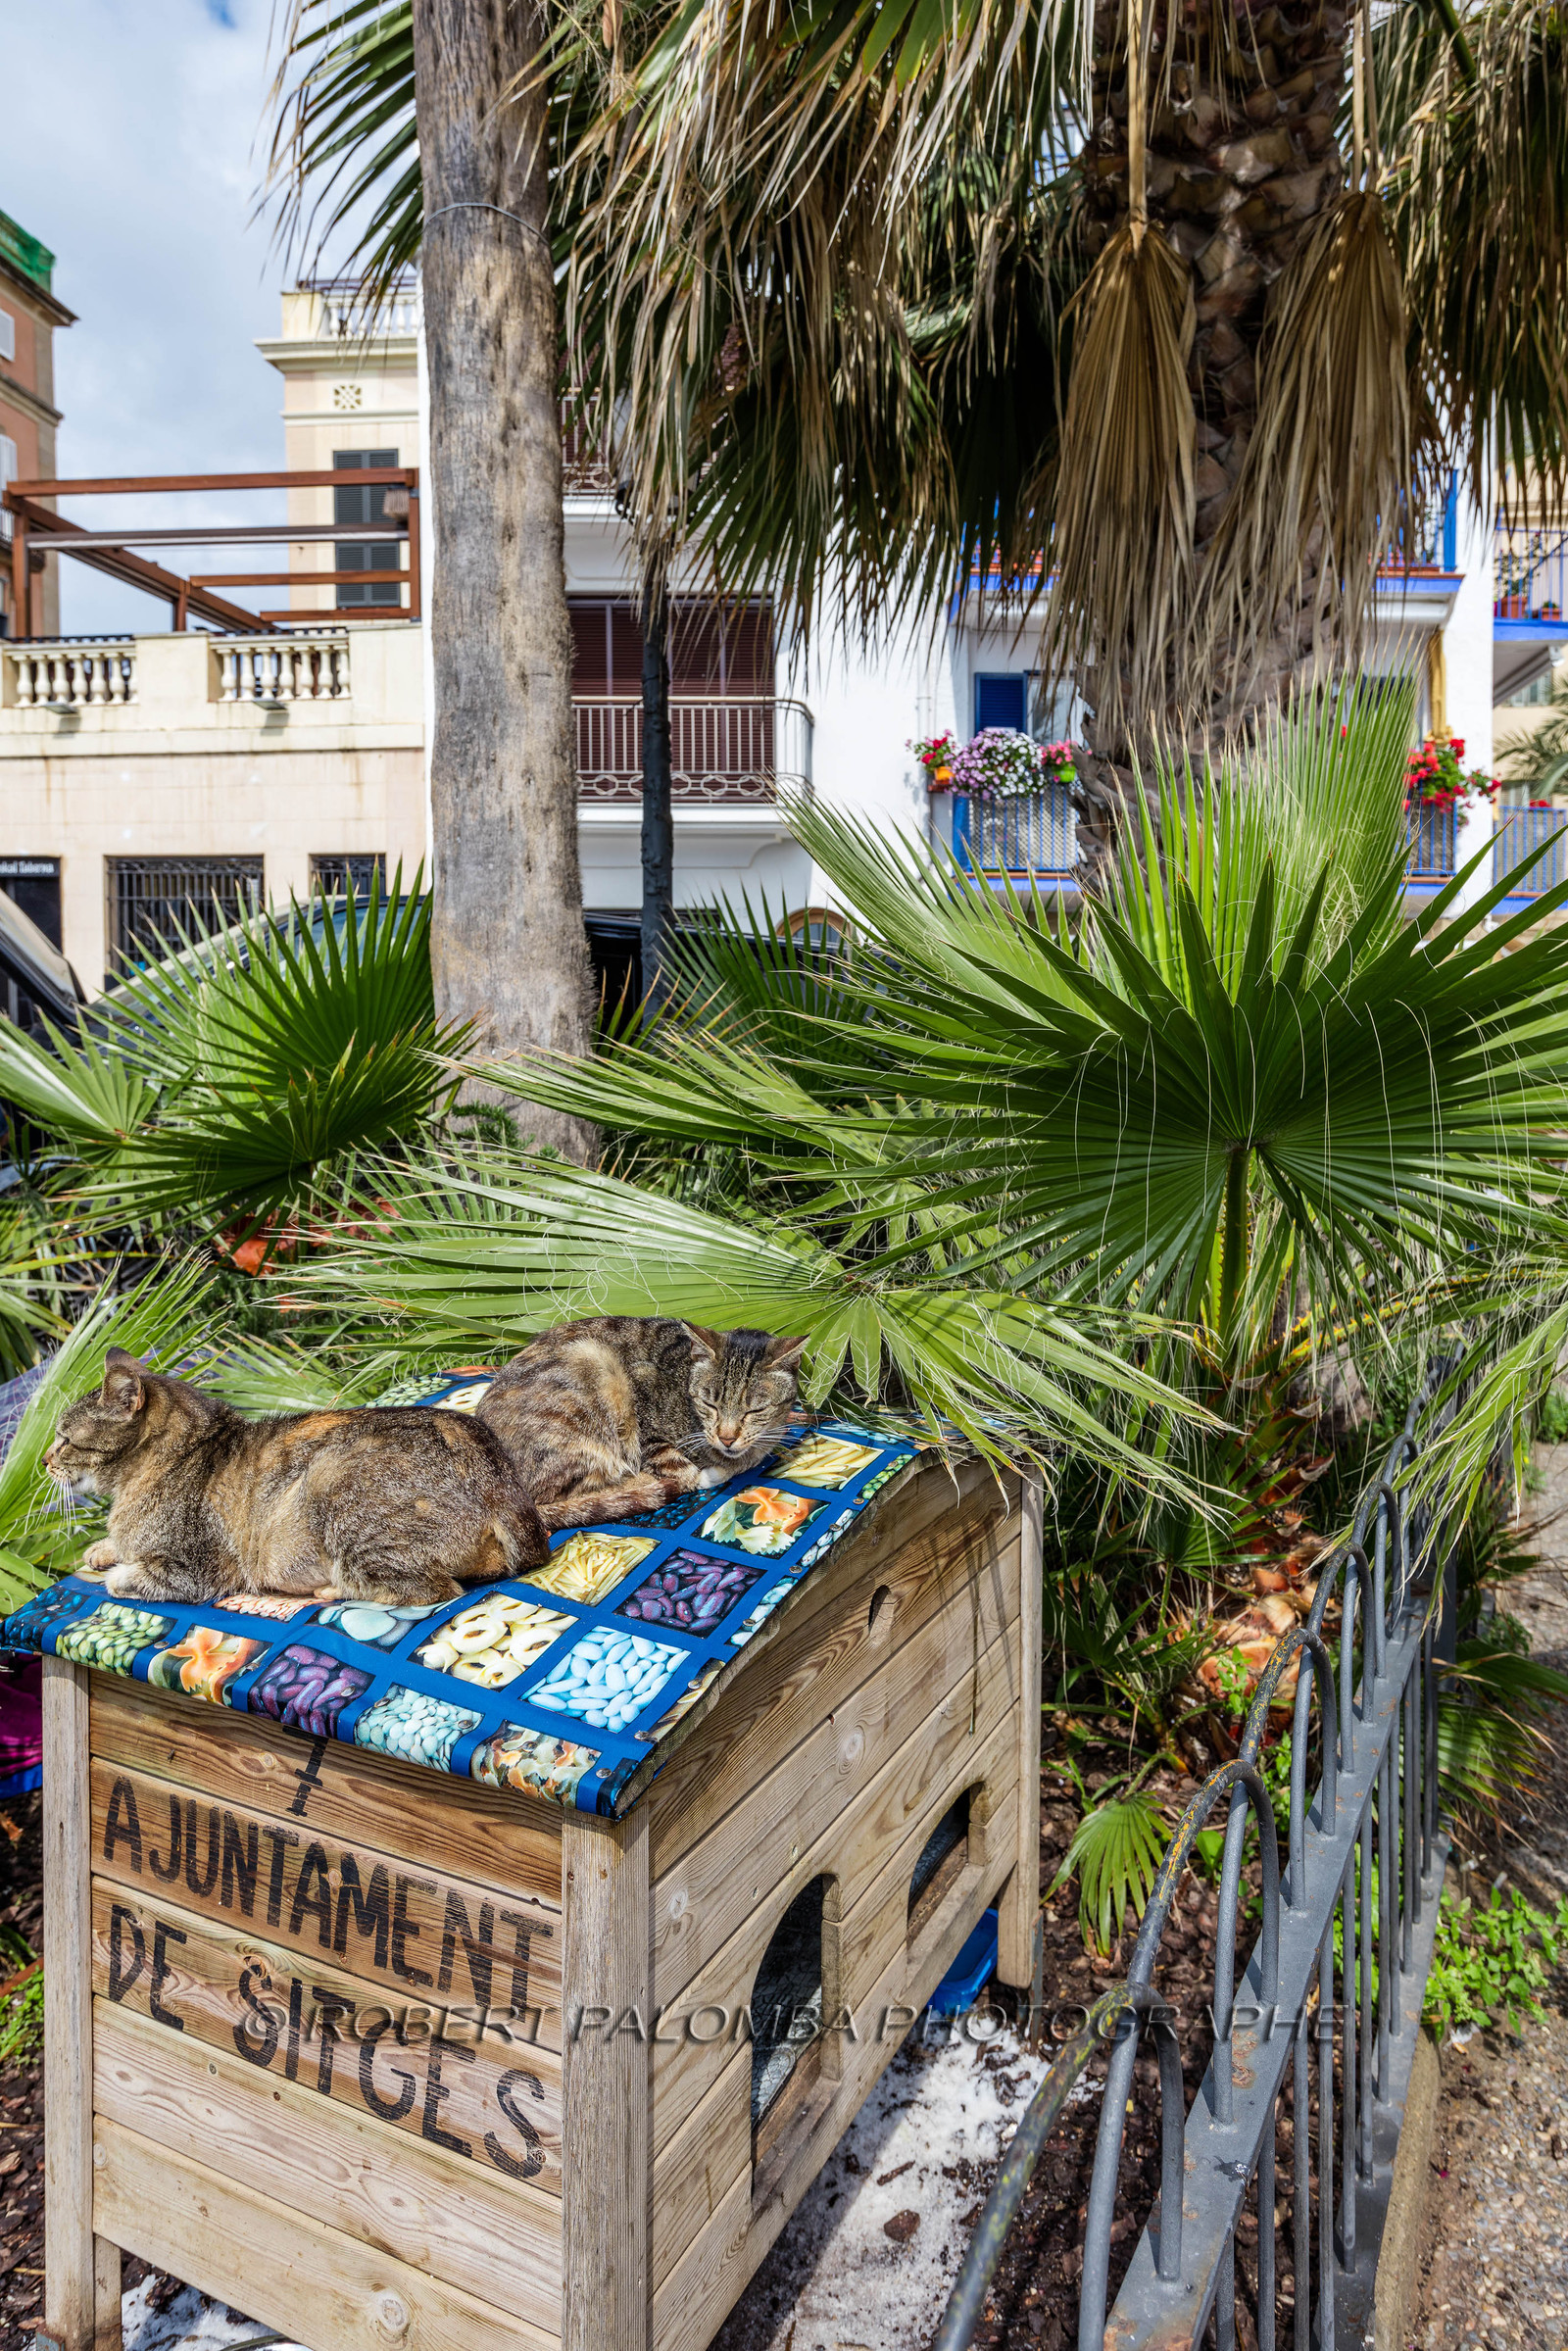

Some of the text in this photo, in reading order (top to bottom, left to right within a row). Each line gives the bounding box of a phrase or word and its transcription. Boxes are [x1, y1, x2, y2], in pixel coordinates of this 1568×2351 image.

[103, 1775, 554, 2023] AJUNTAMENT
[108, 1903, 187, 2032] DE
[232, 1956, 547, 2180] SITGES
